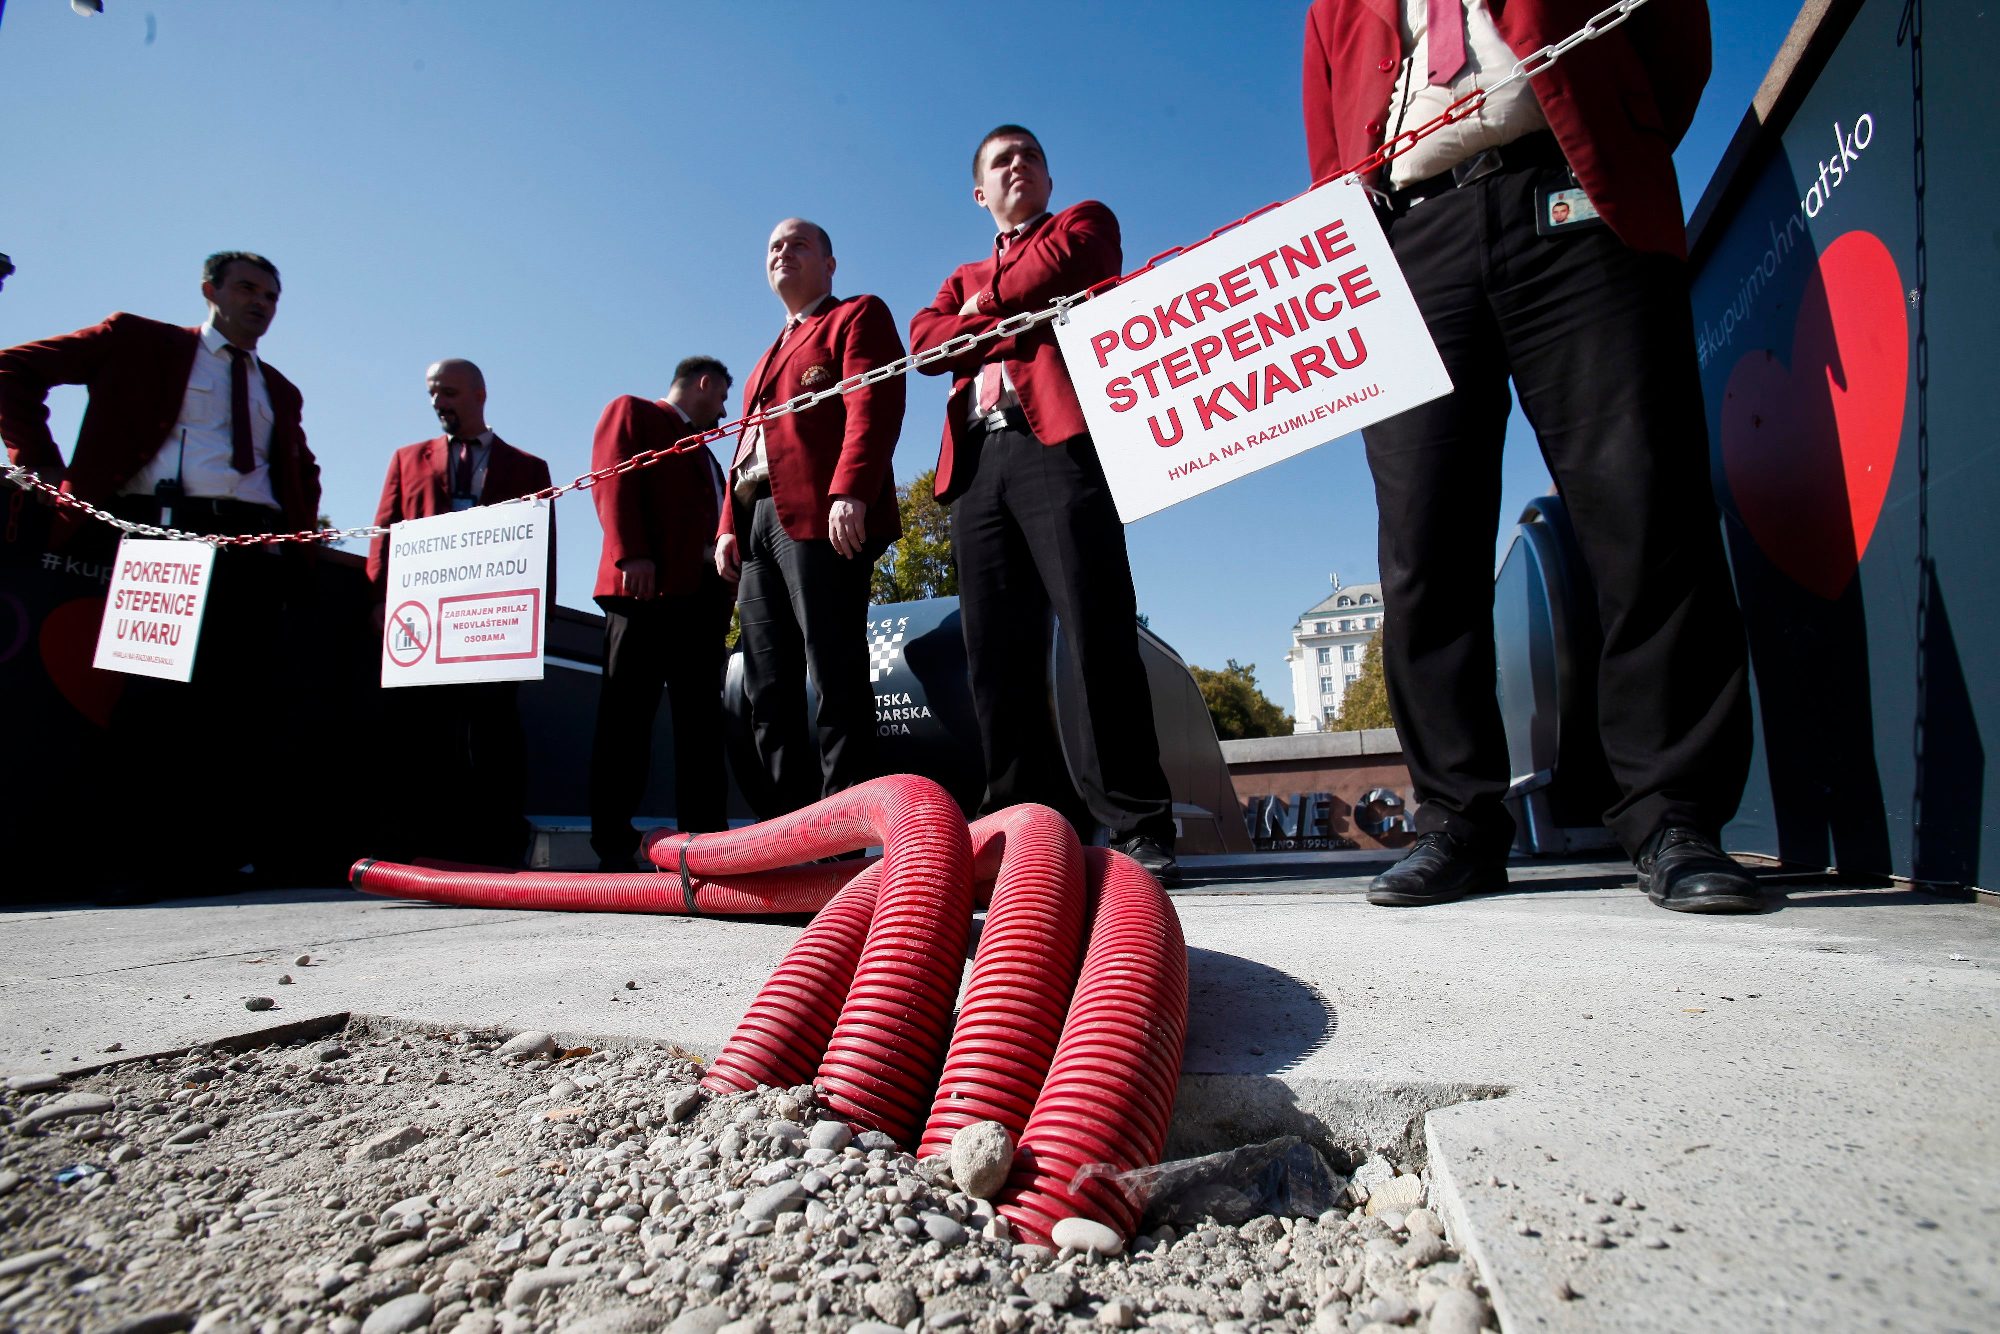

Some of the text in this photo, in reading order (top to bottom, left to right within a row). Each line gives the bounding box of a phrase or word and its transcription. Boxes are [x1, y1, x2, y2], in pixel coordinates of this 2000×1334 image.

[1090, 218, 1357, 369] POKRETNE
[1105, 264, 1382, 414] STEPENICE
[1147, 326, 1369, 449] U KVARU
[1168, 383, 1386, 482] HVALA NA RAZUMIJEVANJU.
[394, 523, 534, 559] POKRETNE STEPENICE
[121, 560, 202, 586] POKRETNE
[402, 558, 527, 588] U PROBNOM RADU
[115, 589, 197, 617] STEPENICE
[444, 604, 528, 619] ZABRANJEN PRILAZ
[117, 618, 182, 647] U KVARU
[453, 617, 519, 630] NEOVLAŠTENIM
[464, 633, 506, 643] OSOBAMA
